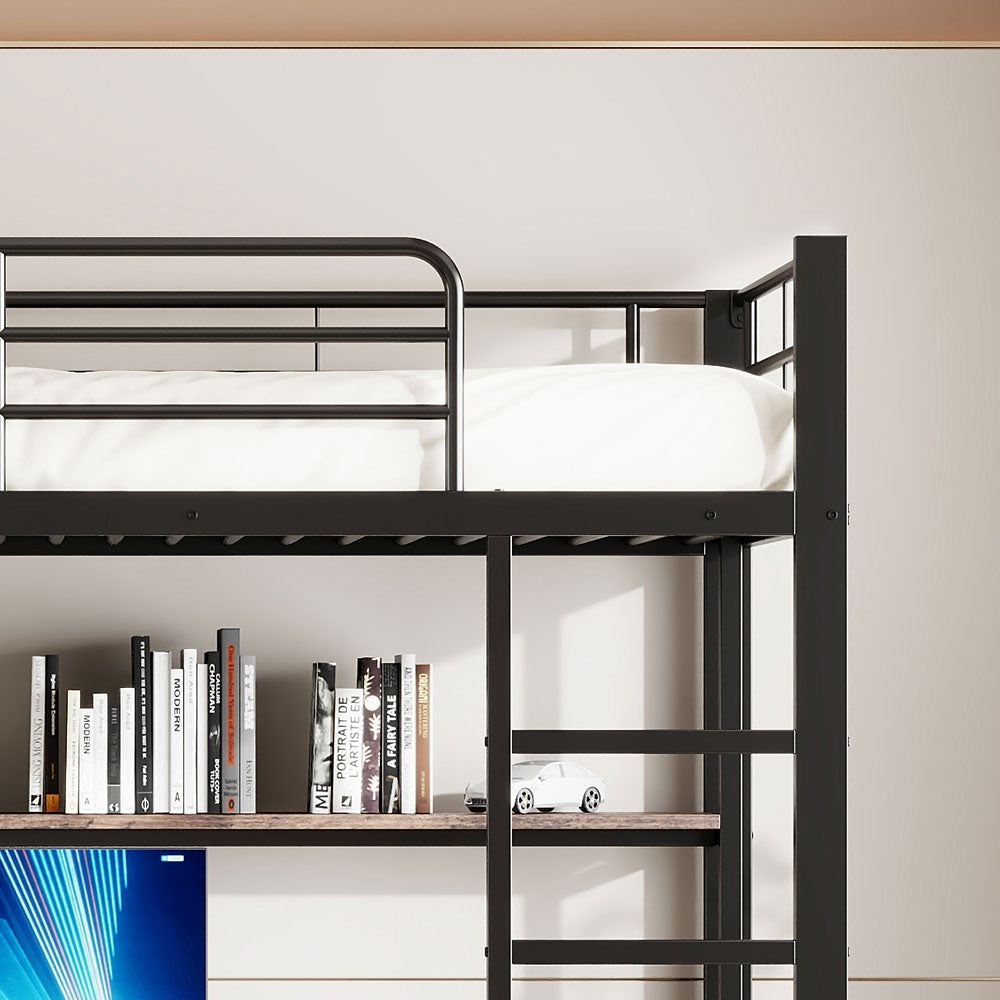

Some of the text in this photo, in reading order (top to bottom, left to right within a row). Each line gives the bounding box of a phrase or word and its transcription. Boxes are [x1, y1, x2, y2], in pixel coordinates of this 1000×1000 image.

[244, 664, 254, 730] STEAM
[387, 694, 397, 722] TALE
[33, 718, 42, 758] MOVING
[336, 698, 348, 779] PORTRAIT DE
[349, 696, 360, 778] L'ARTISTE EN
[386, 725, 397, 758] FAIRY
[386, 760, 396, 768] A
[315, 784, 328, 809] ME
